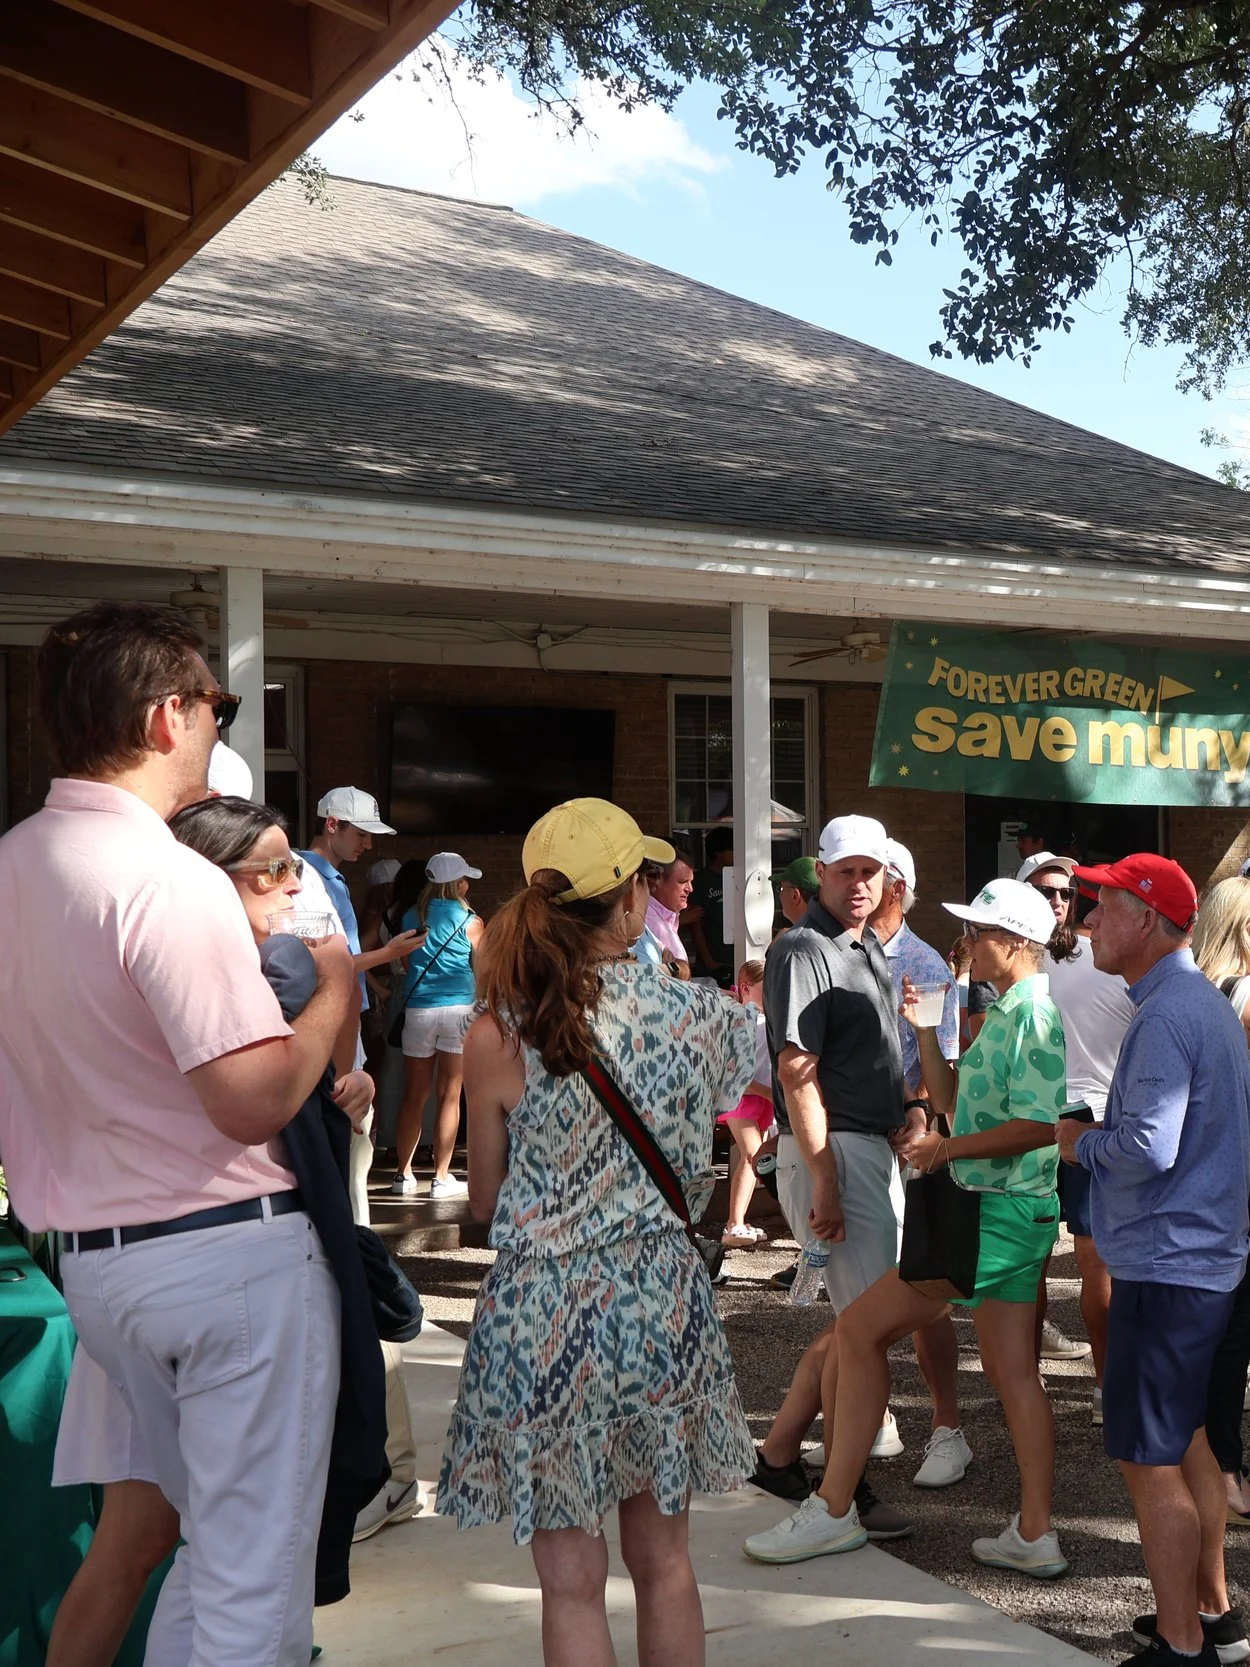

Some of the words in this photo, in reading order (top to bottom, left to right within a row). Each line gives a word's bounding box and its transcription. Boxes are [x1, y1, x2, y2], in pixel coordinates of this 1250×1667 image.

[927, 657, 1060, 704] FOREVER
[1063, 667, 1155, 715] GREEN
[911, 707, 1078, 764] save
[999, 915, 1036, 934] APEX
